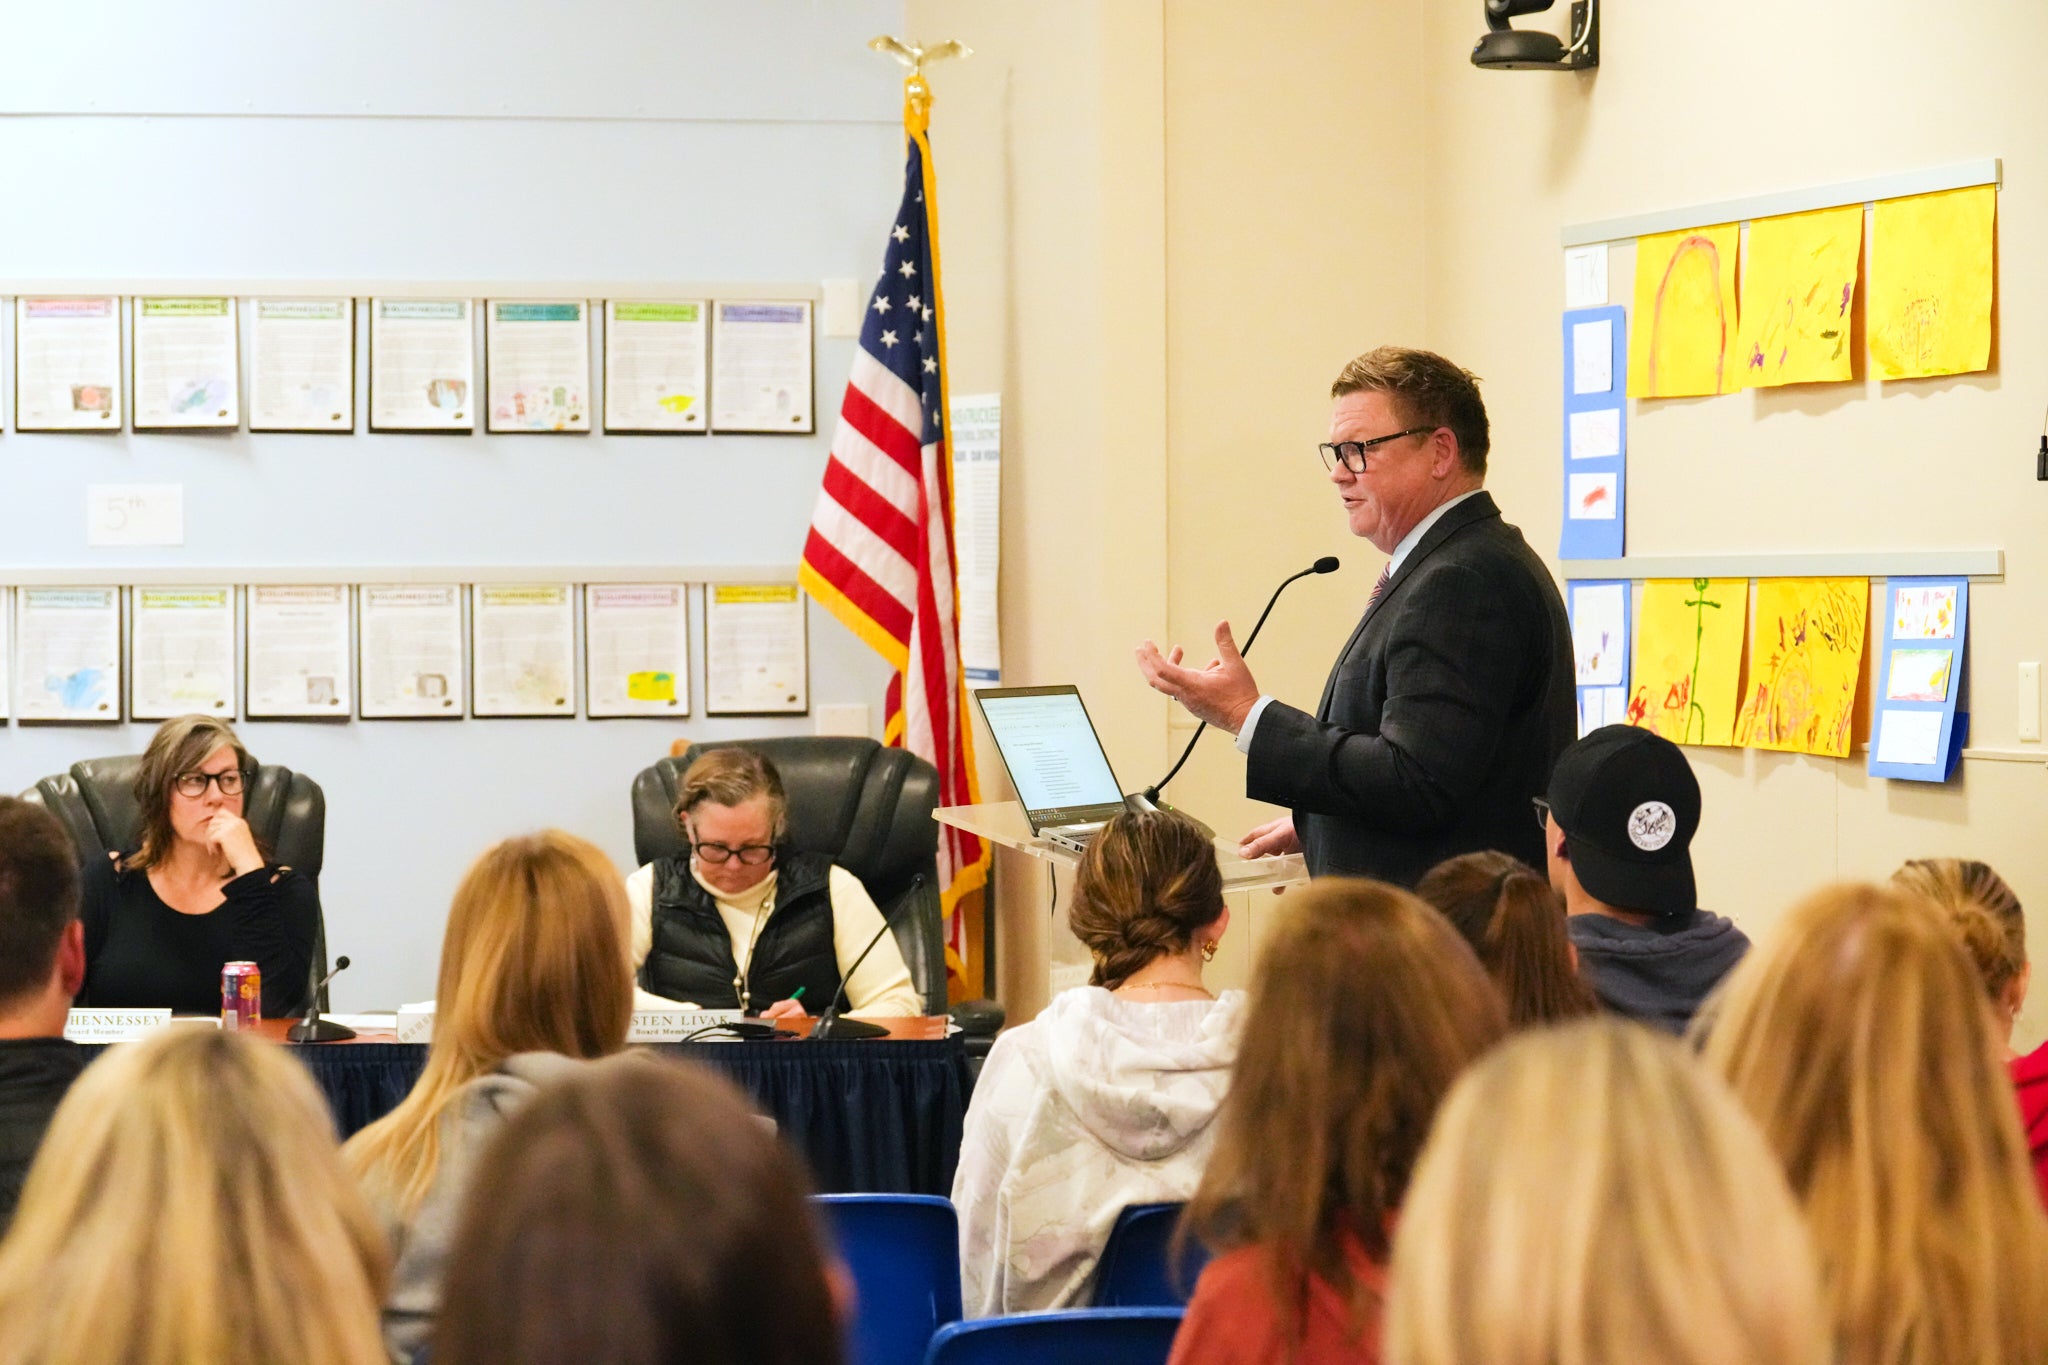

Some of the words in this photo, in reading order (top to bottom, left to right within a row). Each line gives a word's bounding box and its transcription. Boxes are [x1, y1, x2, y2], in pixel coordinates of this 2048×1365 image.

[104, 492, 146, 531] 5th
[70, 1015, 162, 1026] HENNESSEY
[681, 1015, 730, 1026] LIVAK
[93, 1028, 124, 1036] Member
[636, 1028, 659, 1036] Board
